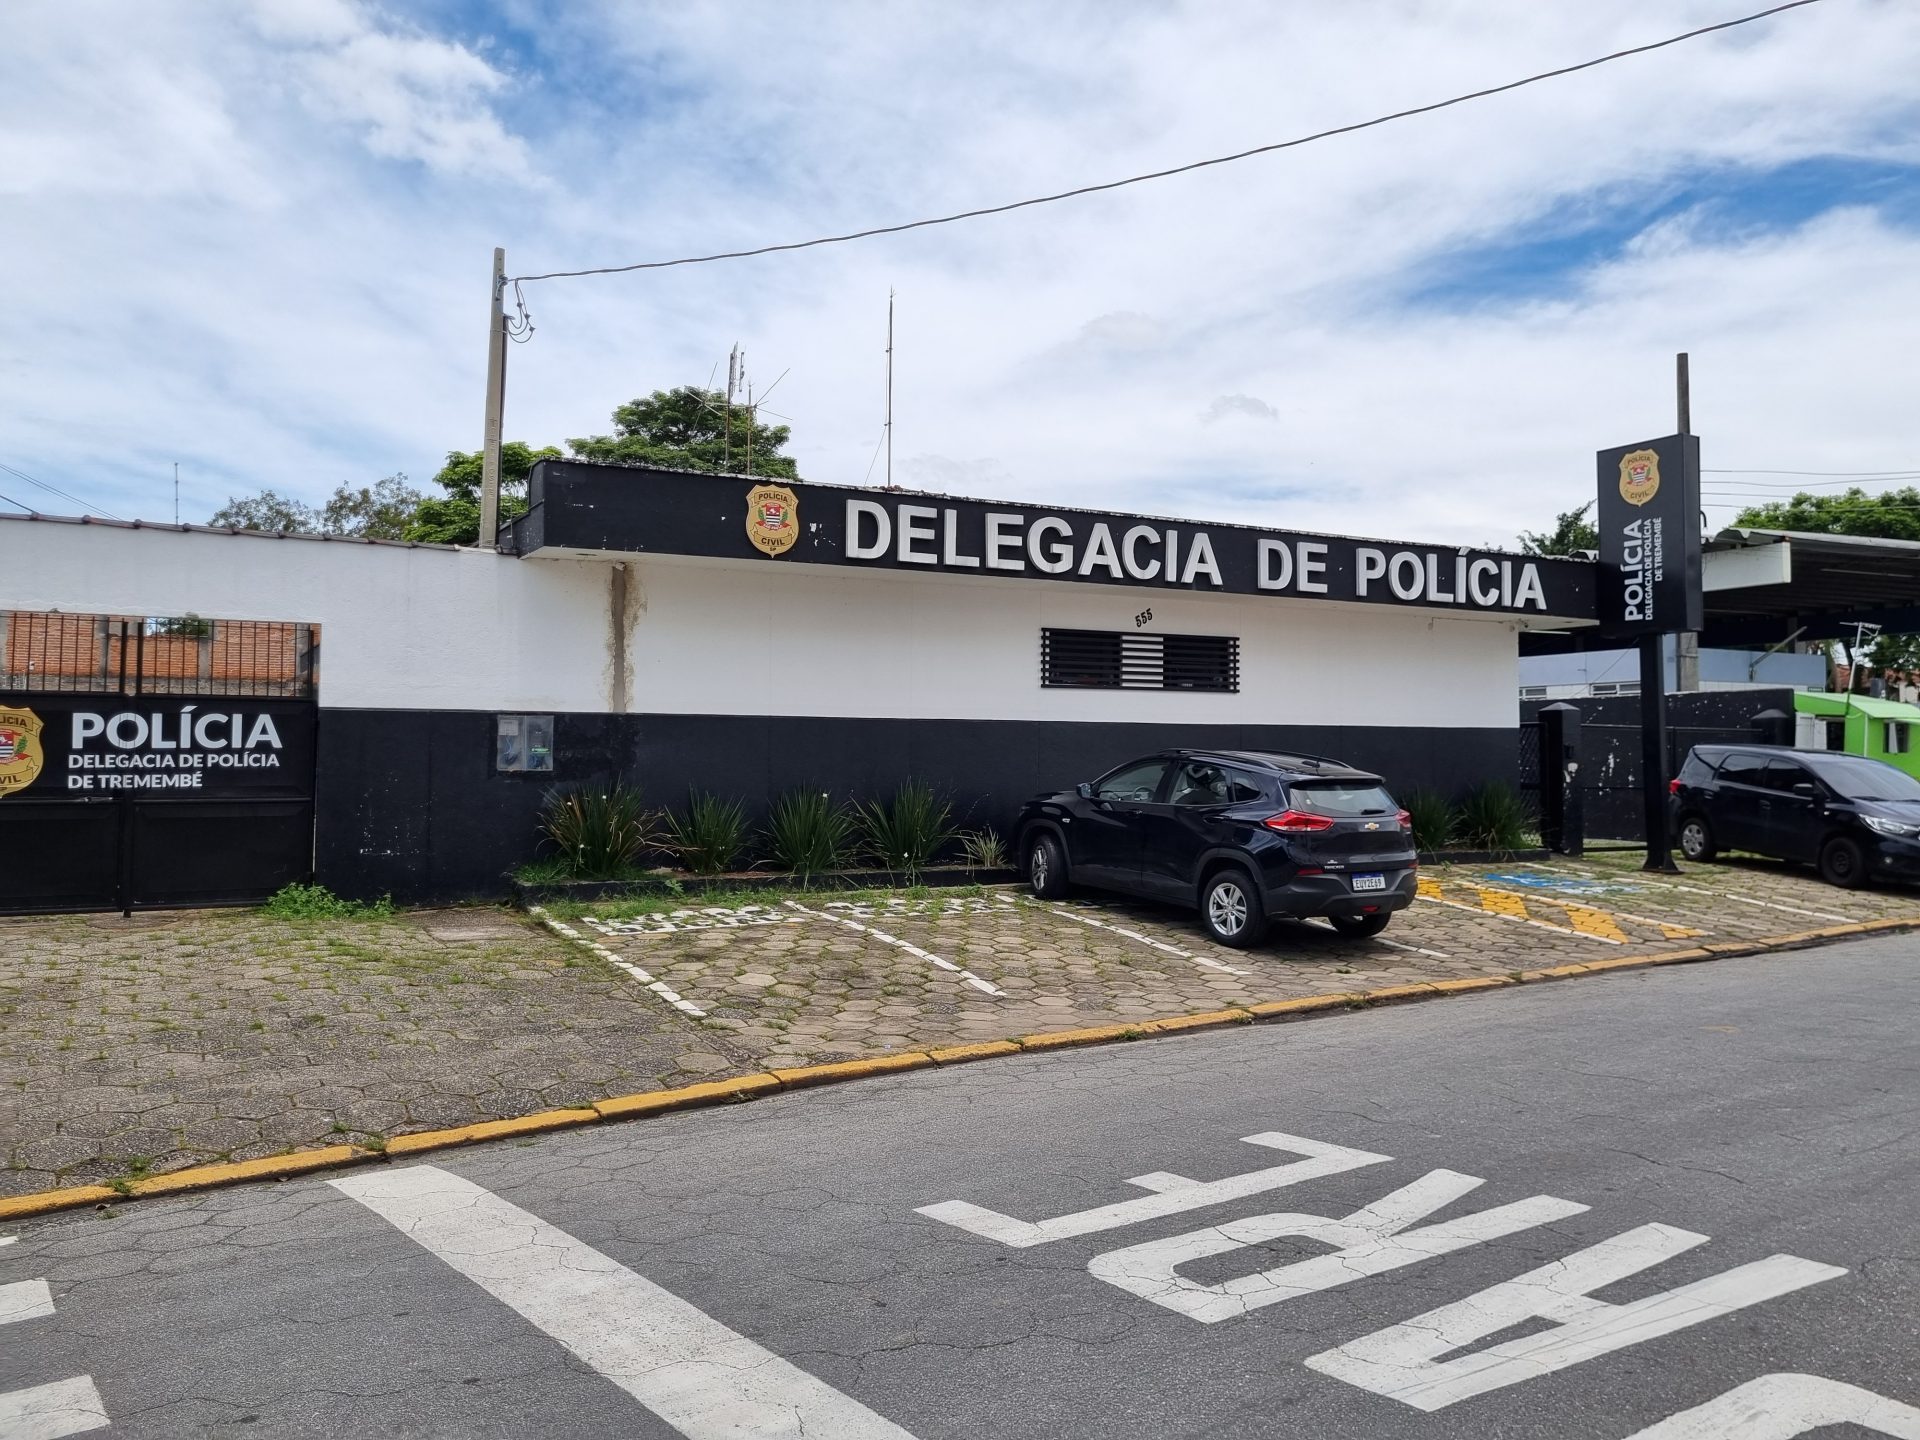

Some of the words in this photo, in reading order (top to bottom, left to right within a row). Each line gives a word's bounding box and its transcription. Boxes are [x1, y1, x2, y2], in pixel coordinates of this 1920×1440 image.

[758, 492, 788, 503] POLÍCIA
[761, 537, 785, 546] CIVIL
[1642, 518, 1652, 556] POLÍCIA
[1652, 516, 1663, 568] TREMEMBÉ
[846, 499, 1223, 586] DELEGACIA
[1257, 538, 1328, 594] DE
[1356, 547, 1547, 610] POLÍCIA
[1644, 556, 1652, 569] DE
[1620, 518, 1643, 621] POLÍCIA
[1654, 568, 1663, 582] DE
[1644, 569, 1653, 621] DELEGACIA
[1135, 607, 1153, 628] 555
[72, 705, 283, 749] POLÍCIA
[68, 754, 175, 769] DELEGACIA
[179, 753, 203, 768] DE
[207, 751, 280, 767] POLÍCIA
[0, 775, 22, 784] VIL
[68, 774, 93, 789] DE
[98, 771, 203, 788] TREMEMBÉ
